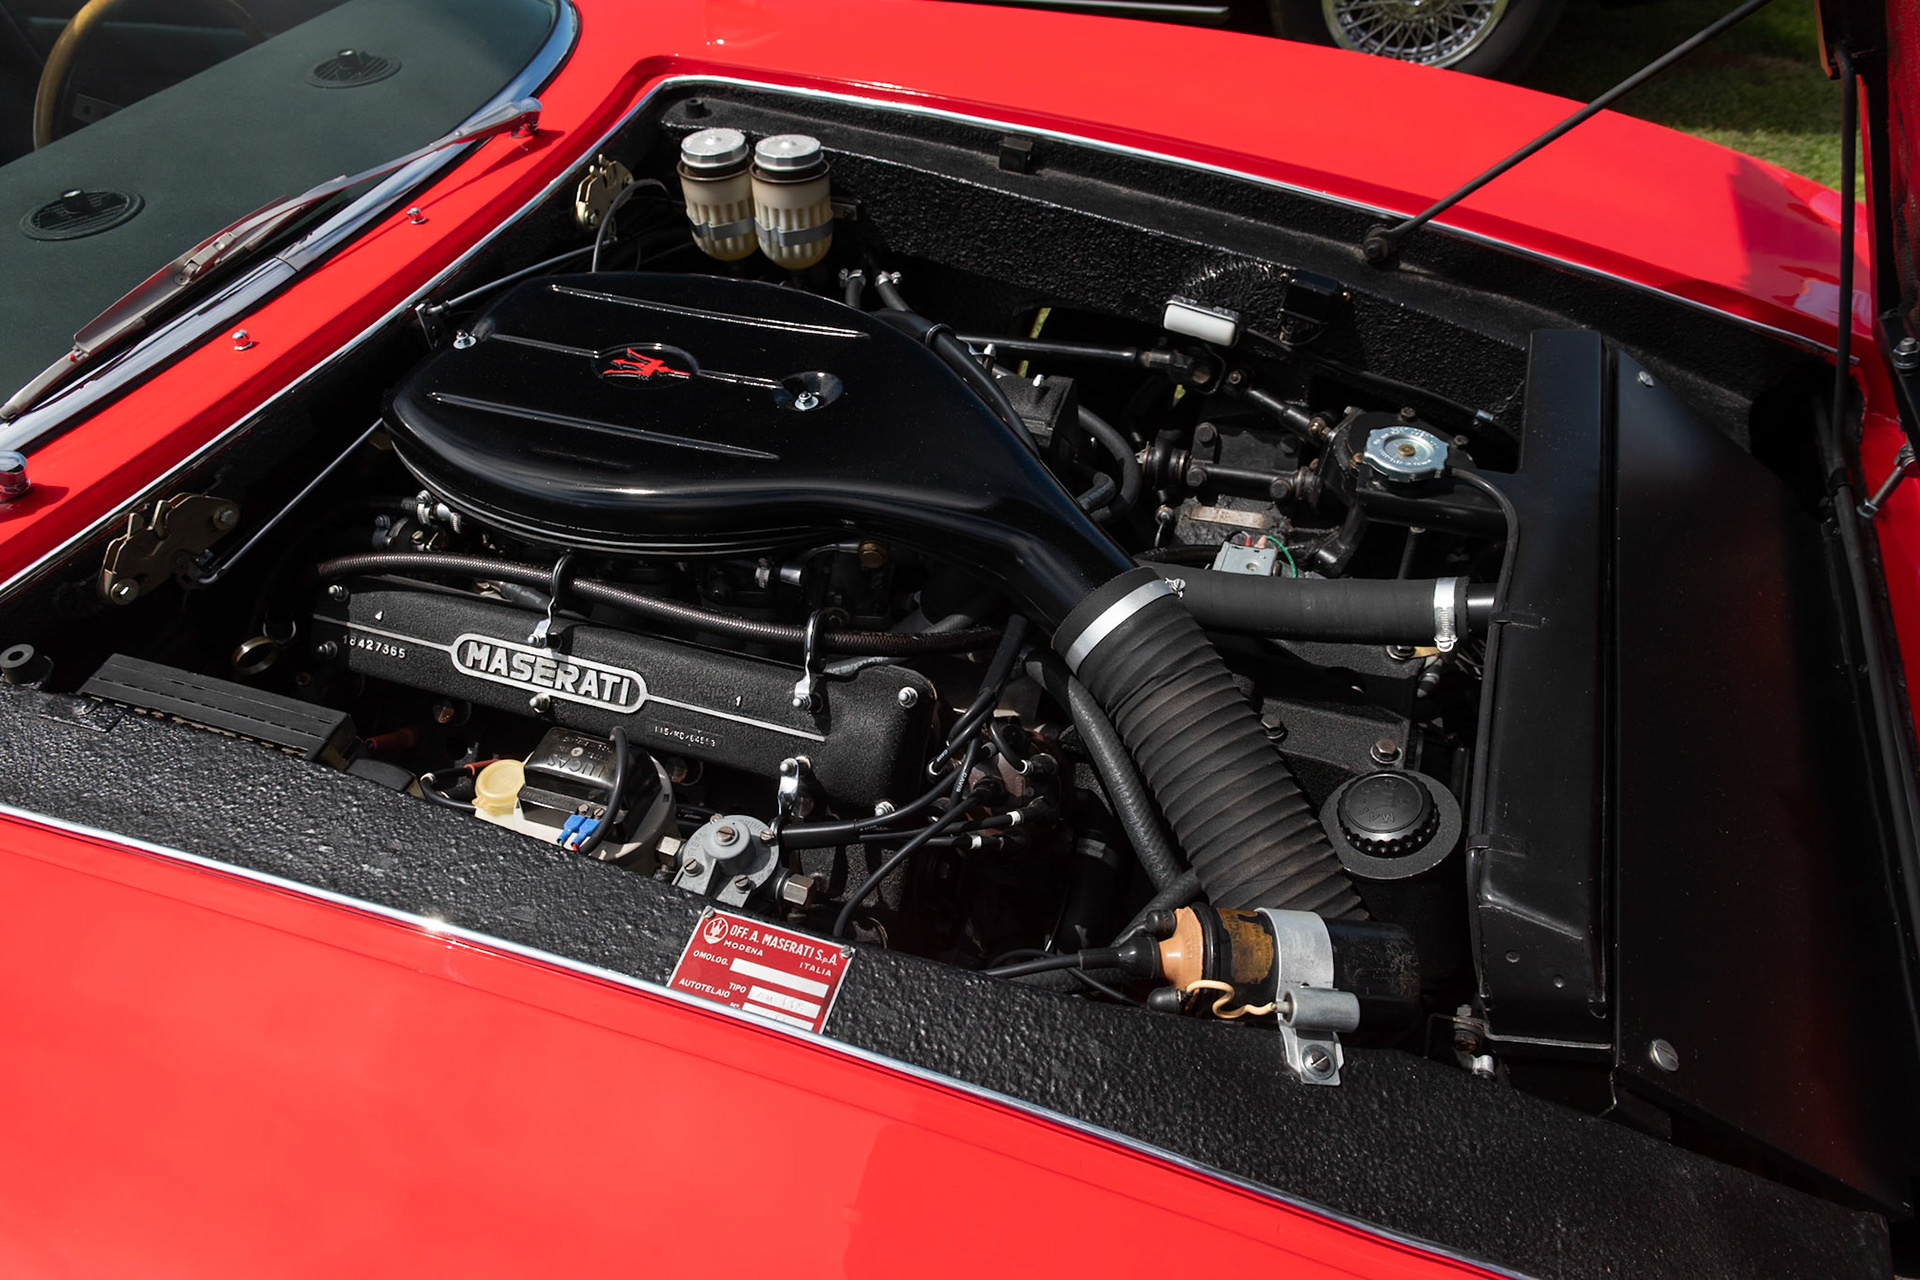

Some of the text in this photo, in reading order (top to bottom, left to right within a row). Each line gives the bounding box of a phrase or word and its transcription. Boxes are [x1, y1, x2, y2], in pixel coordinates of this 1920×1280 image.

[374, 610, 384, 621] 4
[342, 634, 406, 659] 18427365
[465, 641, 631, 706] MASERATI
[735, 695, 742, 707] 1
[955, 772, 968, 793] CAVIS
[723, 939, 764, 957] MODENA
[729, 924, 750, 942] OFF.
[749, 930, 760, 944] A.
[761, 934, 816, 959] MASERATI
[692, 949, 729, 966] OMOLOG.
[799, 961, 832, 977] ITALIA
[678, 977, 731, 998] AUTOTELAIO
[728, 982, 747, 994] TIPO
